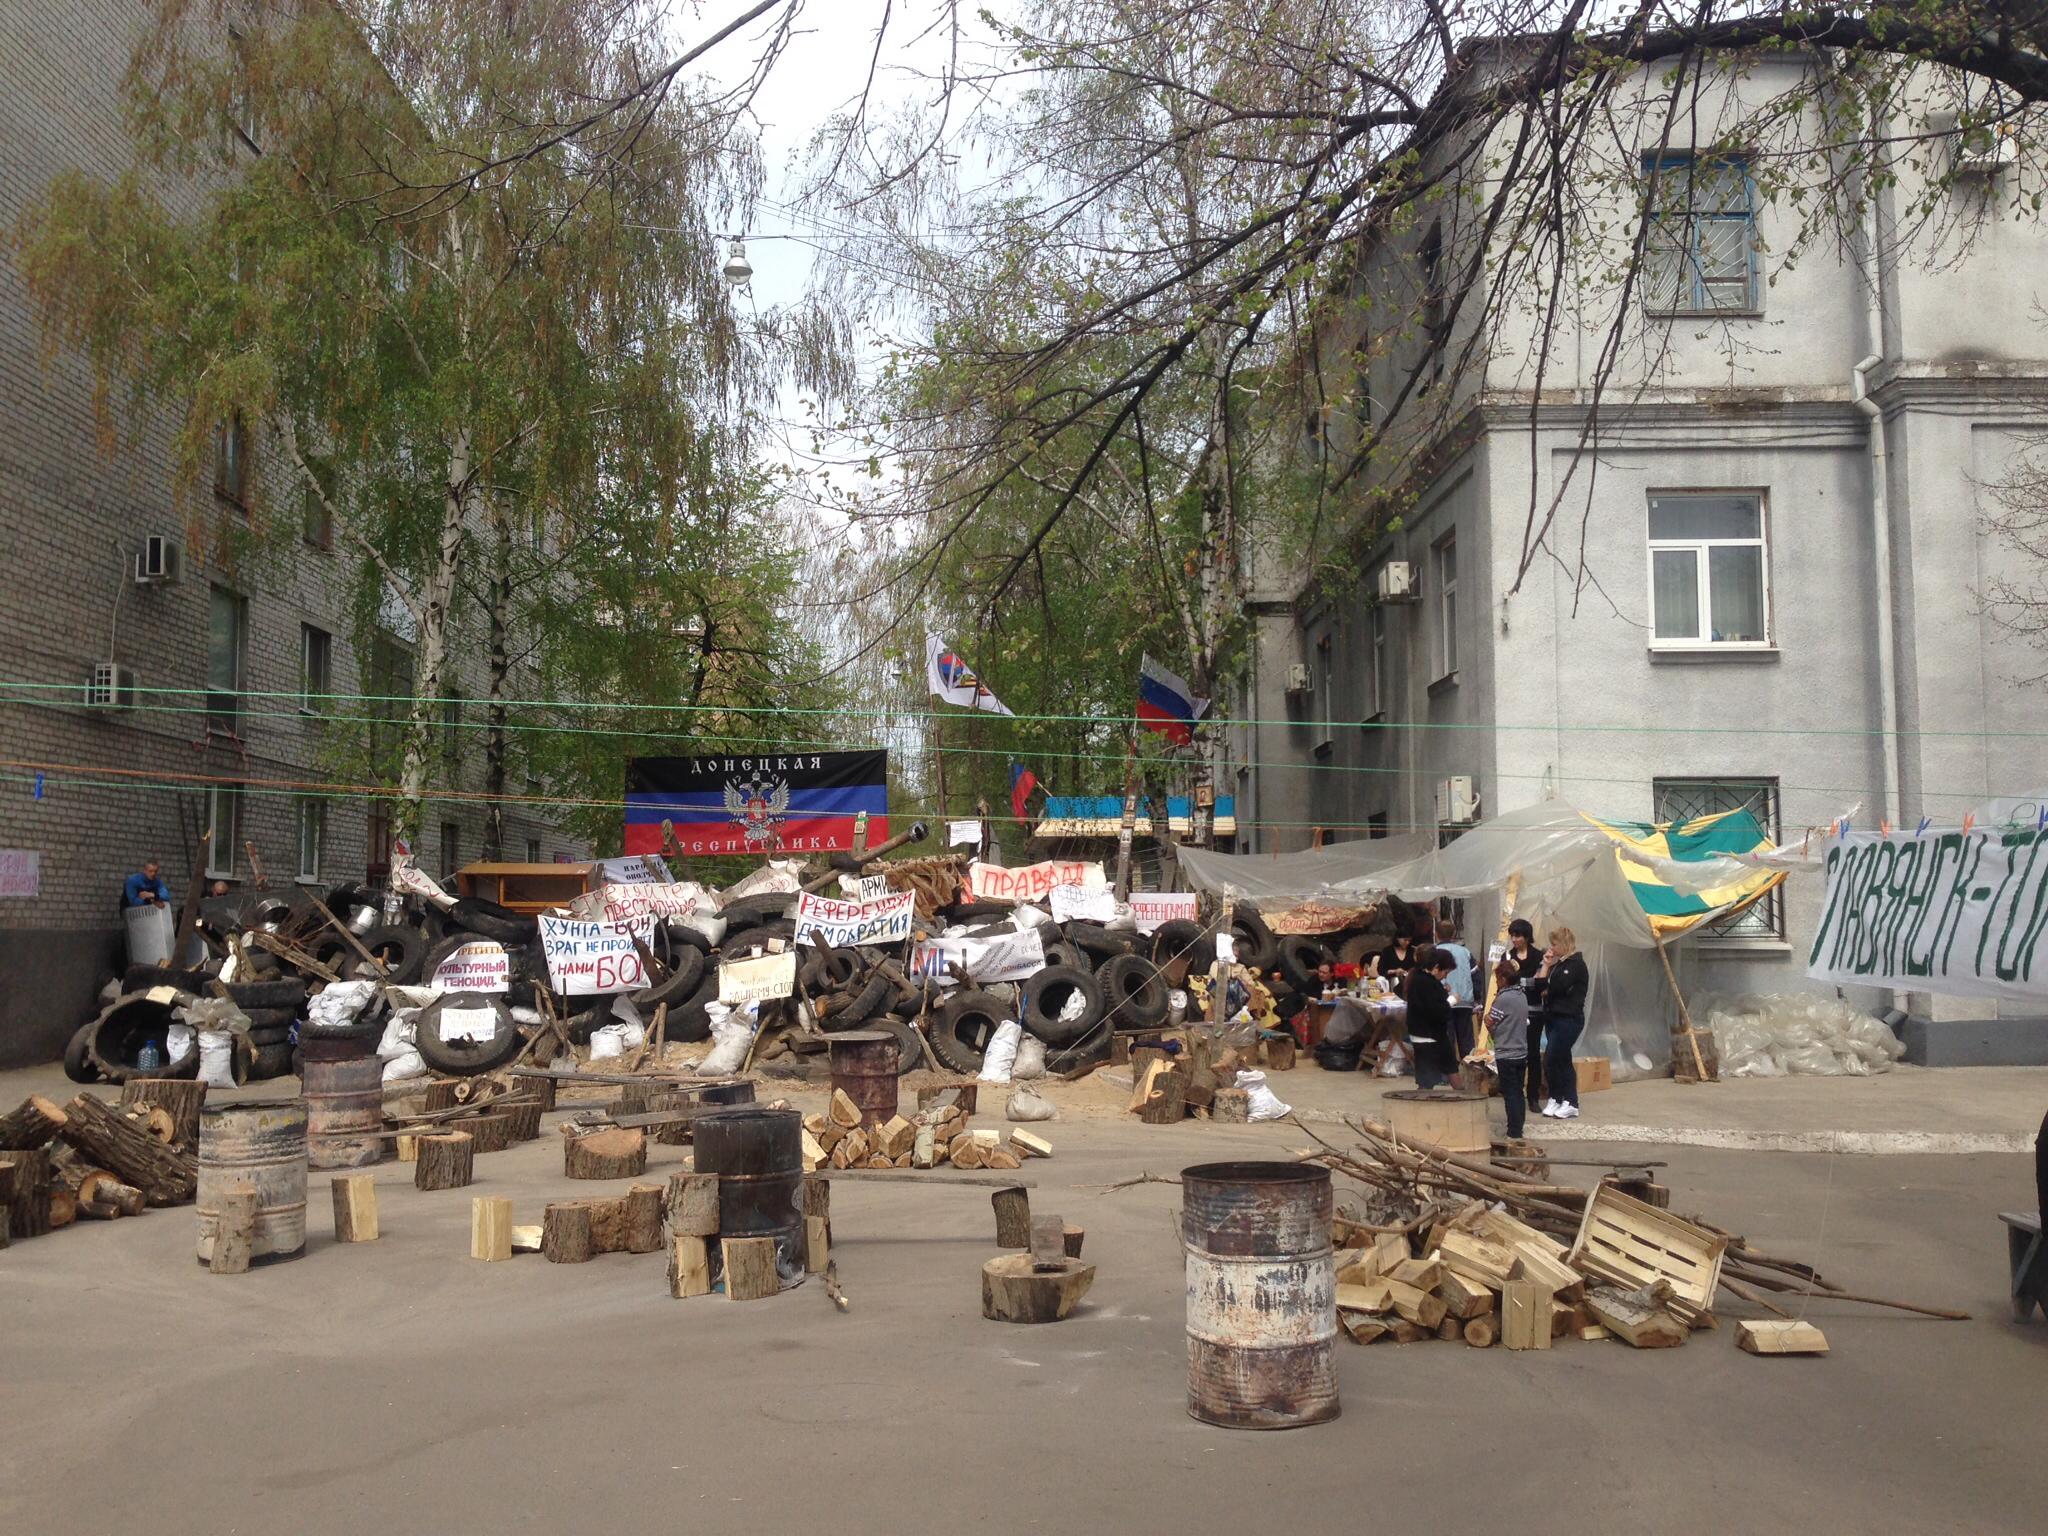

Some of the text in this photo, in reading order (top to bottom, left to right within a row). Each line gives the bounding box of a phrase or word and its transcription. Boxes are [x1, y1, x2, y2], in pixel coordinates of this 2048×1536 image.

[691, 757, 822, 774] ДОНЕЦКАЯ
[586, 941, 599, 953] НЕ
[558, 962, 595, 976] НАМИ
